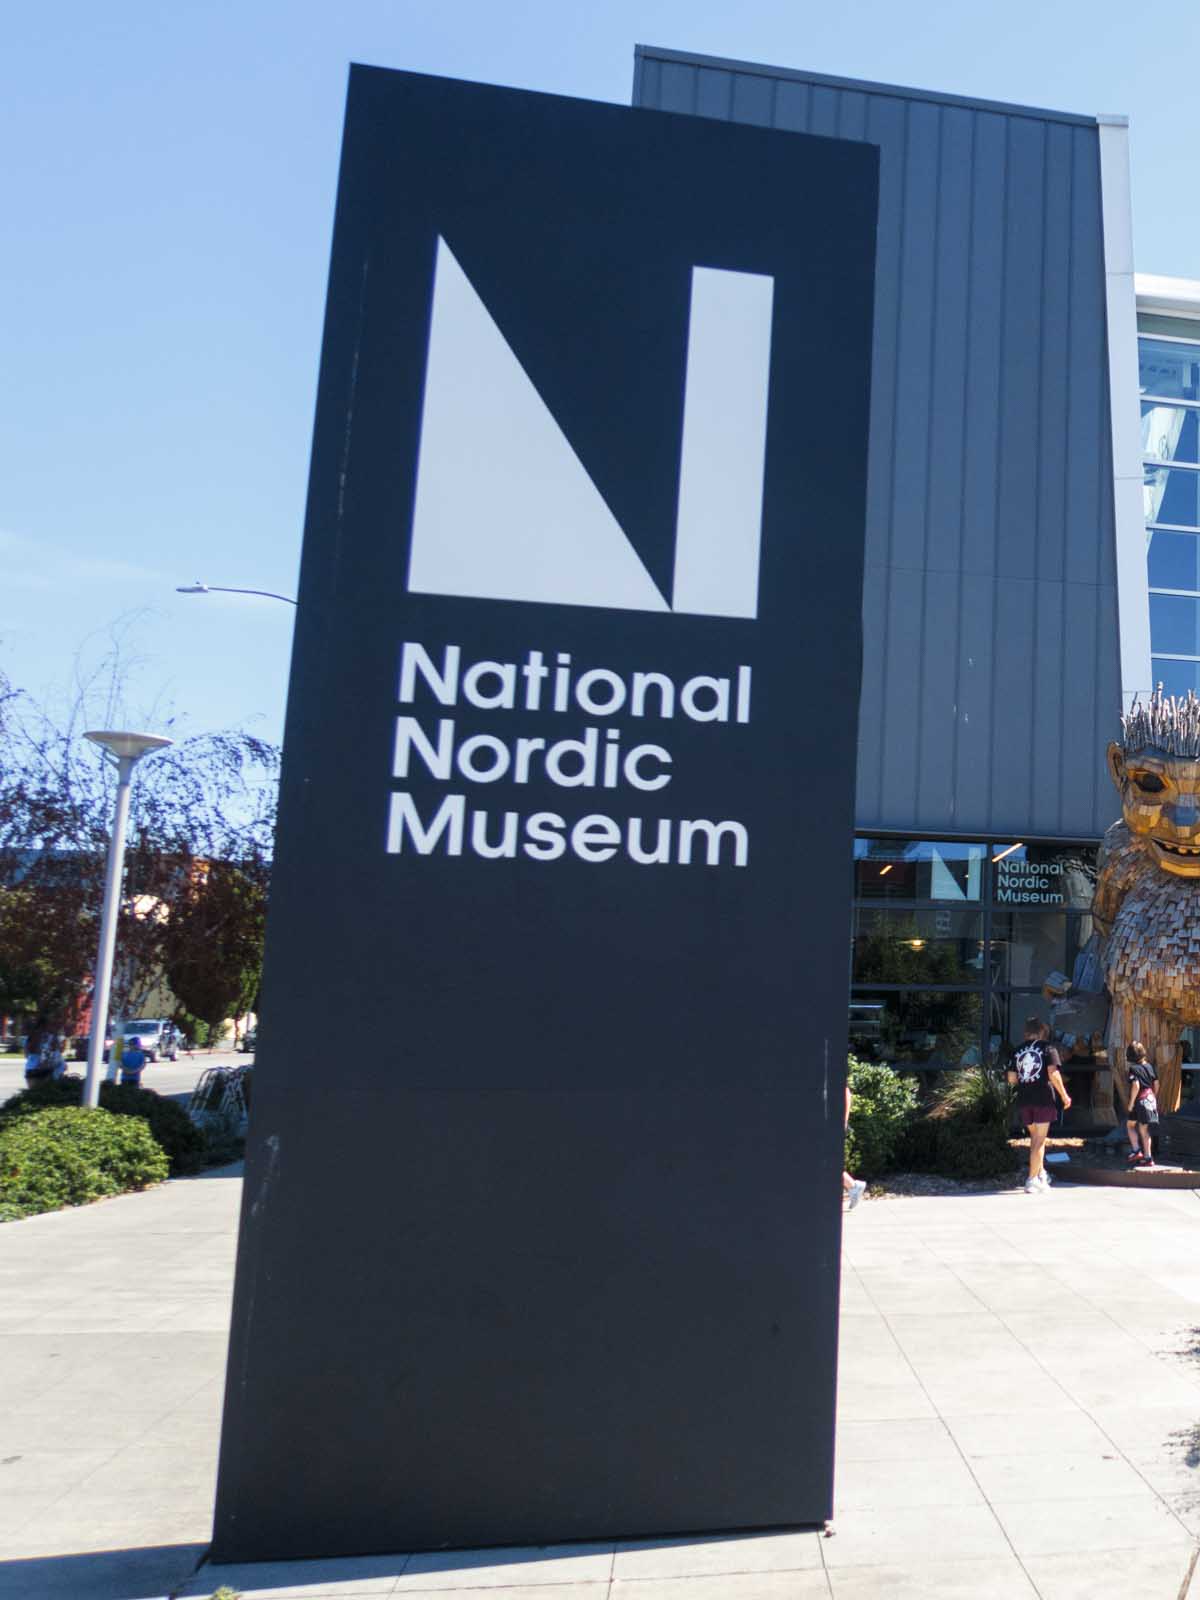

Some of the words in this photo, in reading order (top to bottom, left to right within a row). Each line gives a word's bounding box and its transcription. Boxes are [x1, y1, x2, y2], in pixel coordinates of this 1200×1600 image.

[407, 235, 775, 620] N
[398, 642, 752, 724] National
[391, 716, 673, 792] Nordic
[386, 791, 749, 867] Museum
[930, 847, 982, 901] N
[997, 874, 1049, 890] Nordic
[997, 889, 1064, 904] Museum
[998, 860, 1064, 875] National
